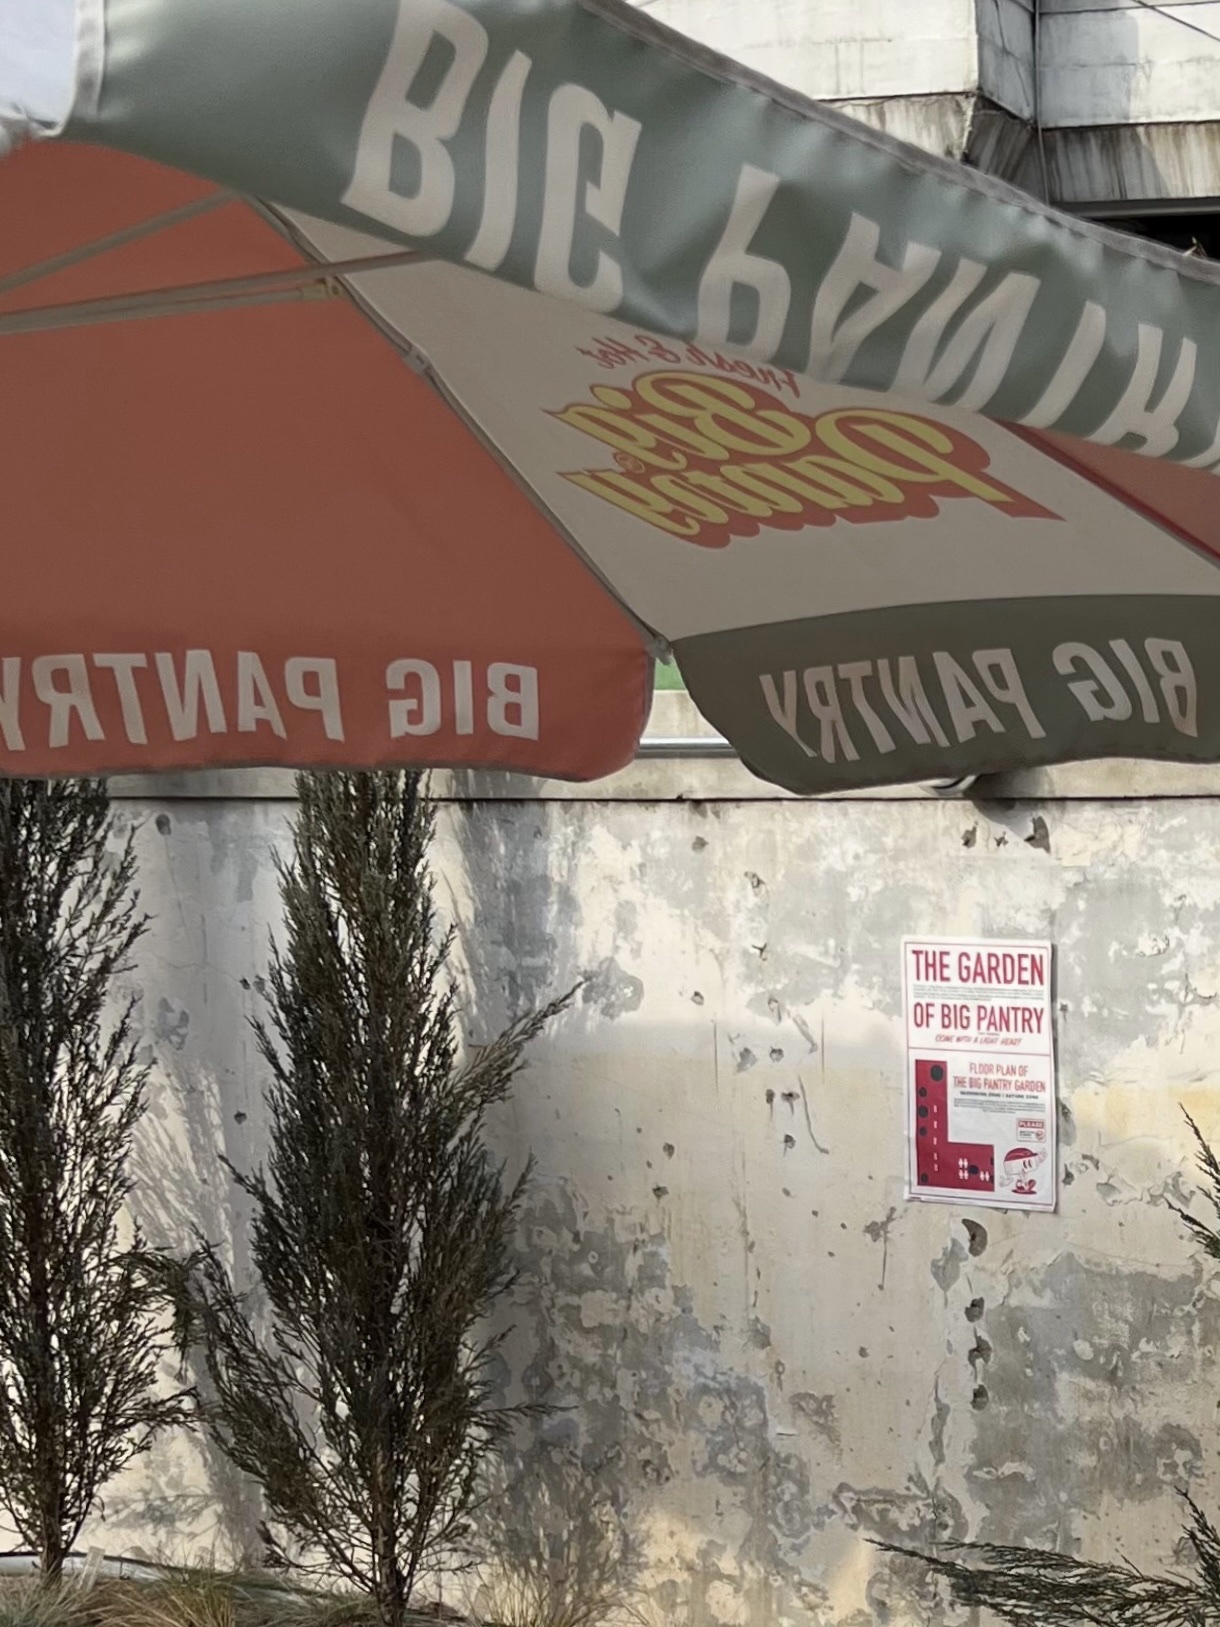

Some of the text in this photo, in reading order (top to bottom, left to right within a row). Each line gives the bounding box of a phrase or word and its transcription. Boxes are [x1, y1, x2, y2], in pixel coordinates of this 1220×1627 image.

[912, 950, 1044, 986] THE GARDEN
[914, 1002, 1044, 1034] OF BIG PANTRY
[969, 1063, 1028, 1076] FLOOR PLAN OF
[953, 1076, 1046, 1093] THE BIG PANTRY GARDEN
